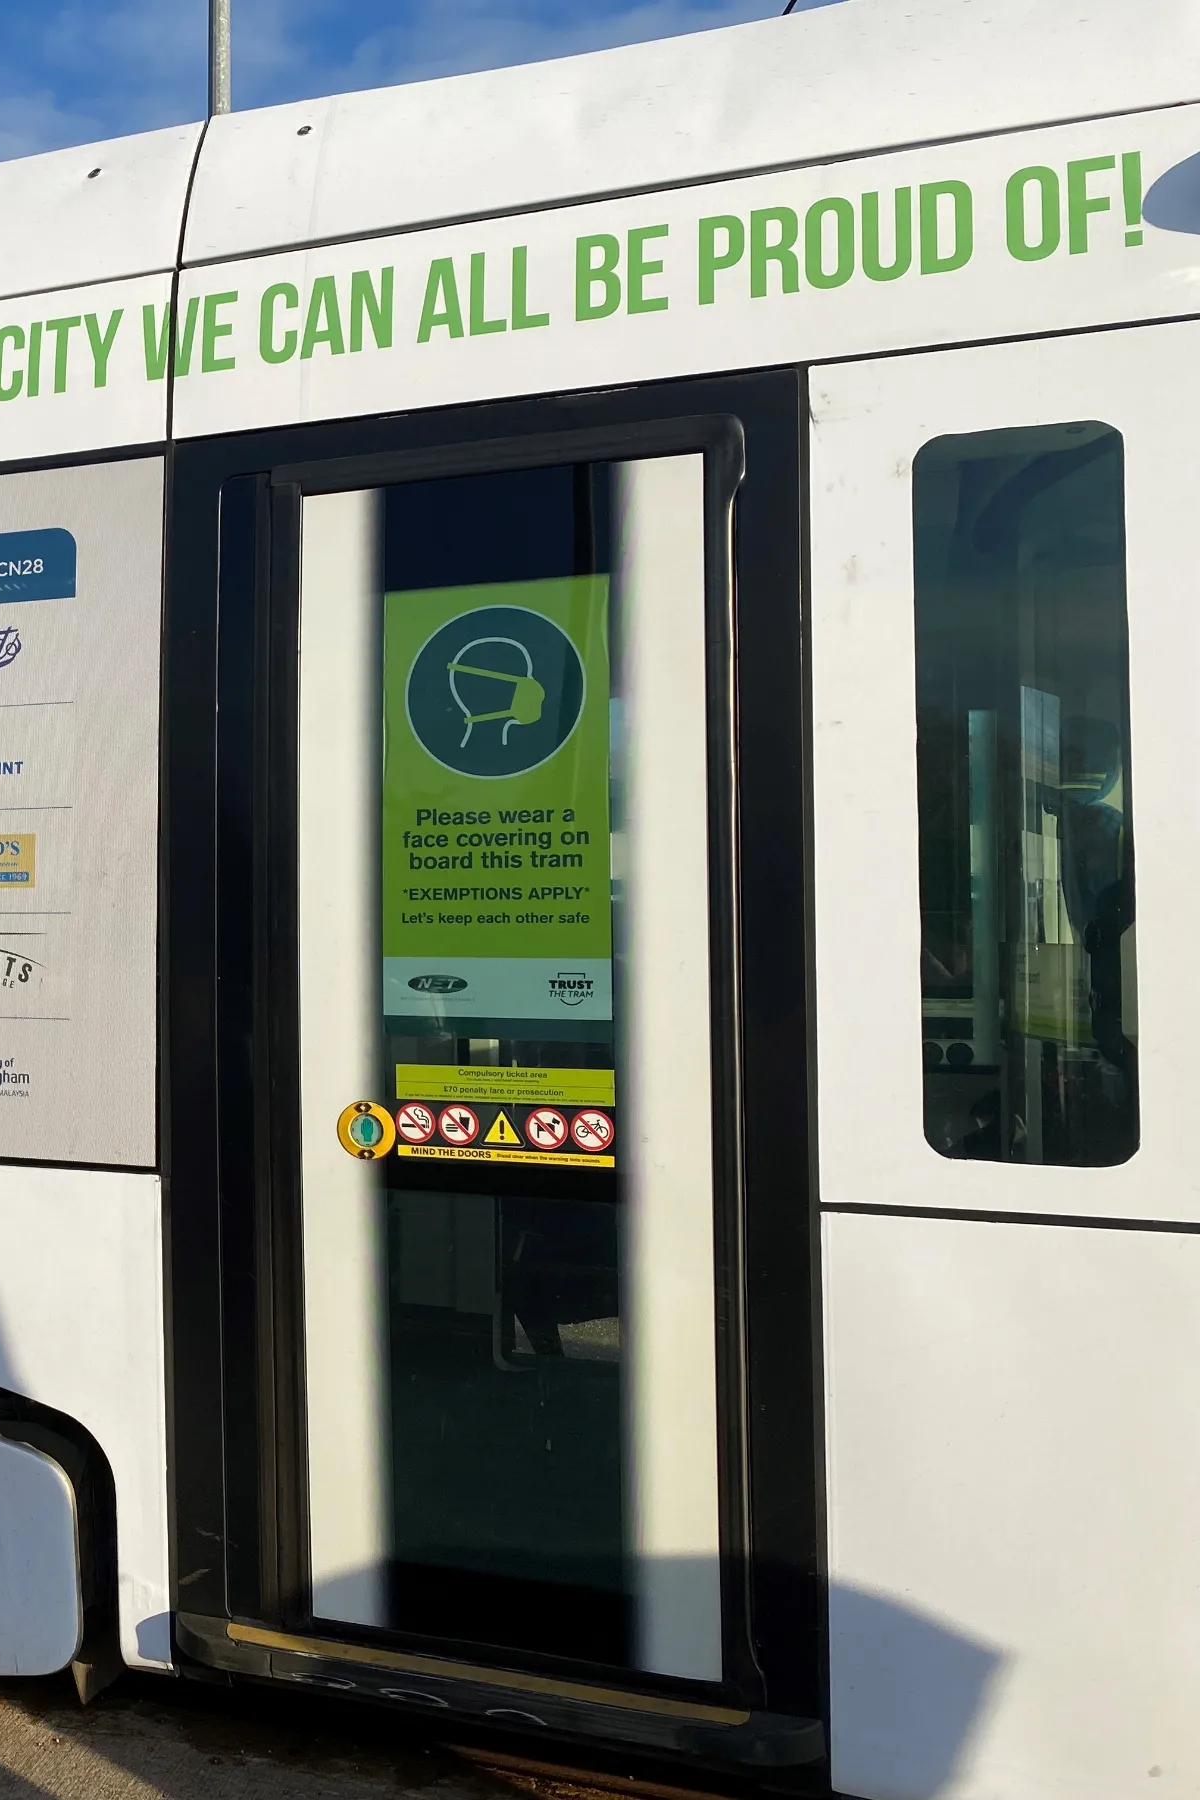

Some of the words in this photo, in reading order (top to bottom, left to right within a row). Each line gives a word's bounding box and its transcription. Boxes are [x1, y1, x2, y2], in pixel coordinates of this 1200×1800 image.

[142, 291, 238, 381] WE
[258, 266, 395, 364] CAN
[416, 245, 550, 344] ALL
[575, 223, 669, 323] BE
[698, 180, 974, 305] PROUD
[1005, 150, 1145, 262] OF!
[416, 808, 491, 826] Please
[498, 808, 555, 824] wear
[562, 808, 576, 823] a
[402, 831, 449, 848] face
[456, 828, 552, 850] covering
[560, 829, 590, 845] on
[409, 851, 473, 870] board
[481, 850, 523, 869] this
[530, 852, 583, 868] tram
[401, 912, 434, 924] Let's
[438, 912, 473, 926] keep
[477, 912, 511, 924] each
[515, 912, 554, 924] other
[558, 912, 590, 924] safe
[417, 978, 459, 989] NET
[548, 979, 594, 990] TRUST
[548, 989, 567, 998] THE
[567, 989, 594, 998] TRAM
[4, 1058, 15, 1067] of
[458, 1069, 504, 1078] Compulsory
[506, 1070, 528, 1078] ticket
[460, 1086, 488, 1095] penalty
[517, 1088, 564, 1096] prosecution
[411, 1146, 436, 1156] MIND
[437, 1148, 456, 1157] THE
[457, 1149, 492, 1159] DOORS
